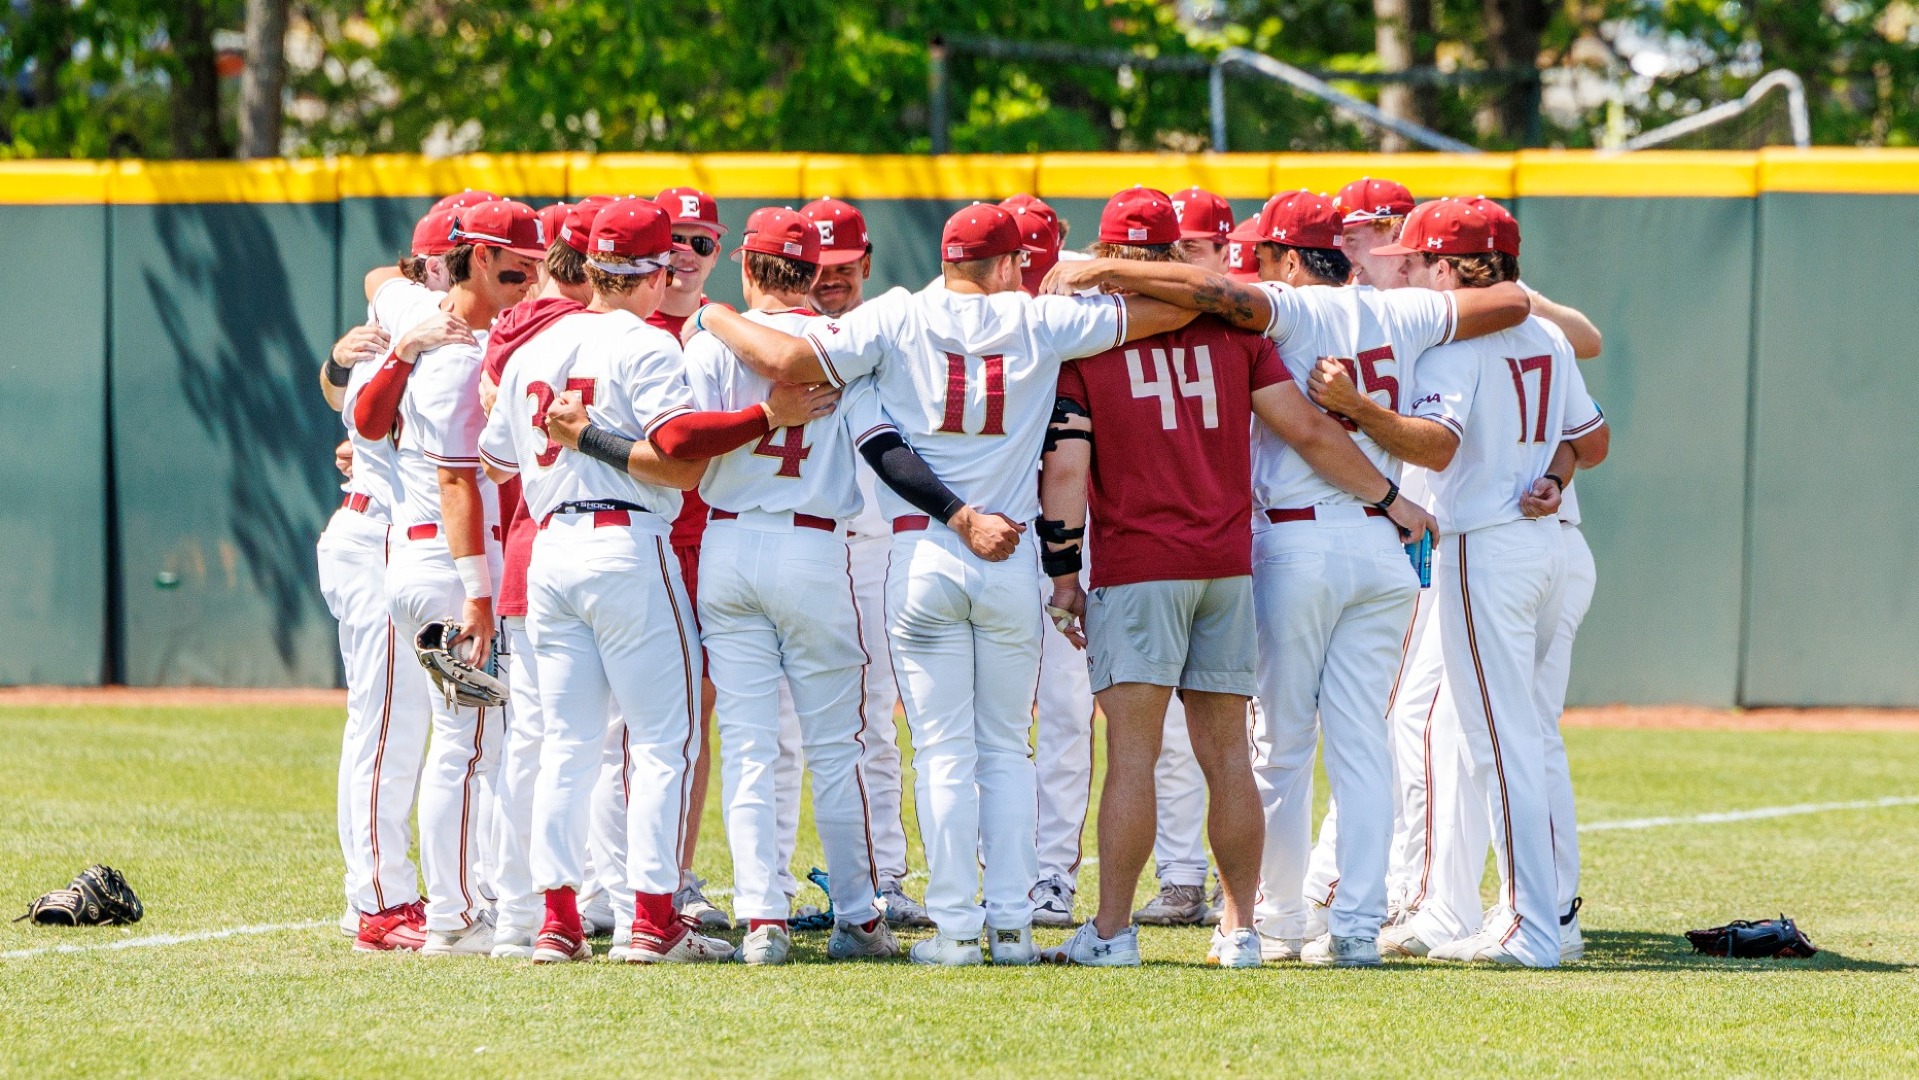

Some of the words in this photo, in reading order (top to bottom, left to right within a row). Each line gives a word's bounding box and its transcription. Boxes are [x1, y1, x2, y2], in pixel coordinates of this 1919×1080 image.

[679, 195, 700, 218] E
[814, 220, 835, 245] E
[1229, 243, 1243, 268] E
[936, 349, 1008, 437] 11
[1124, 345, 1218, 430] 44
[1502, 354, 1552, 444] 17
[751, 424, 814, 479] 4
